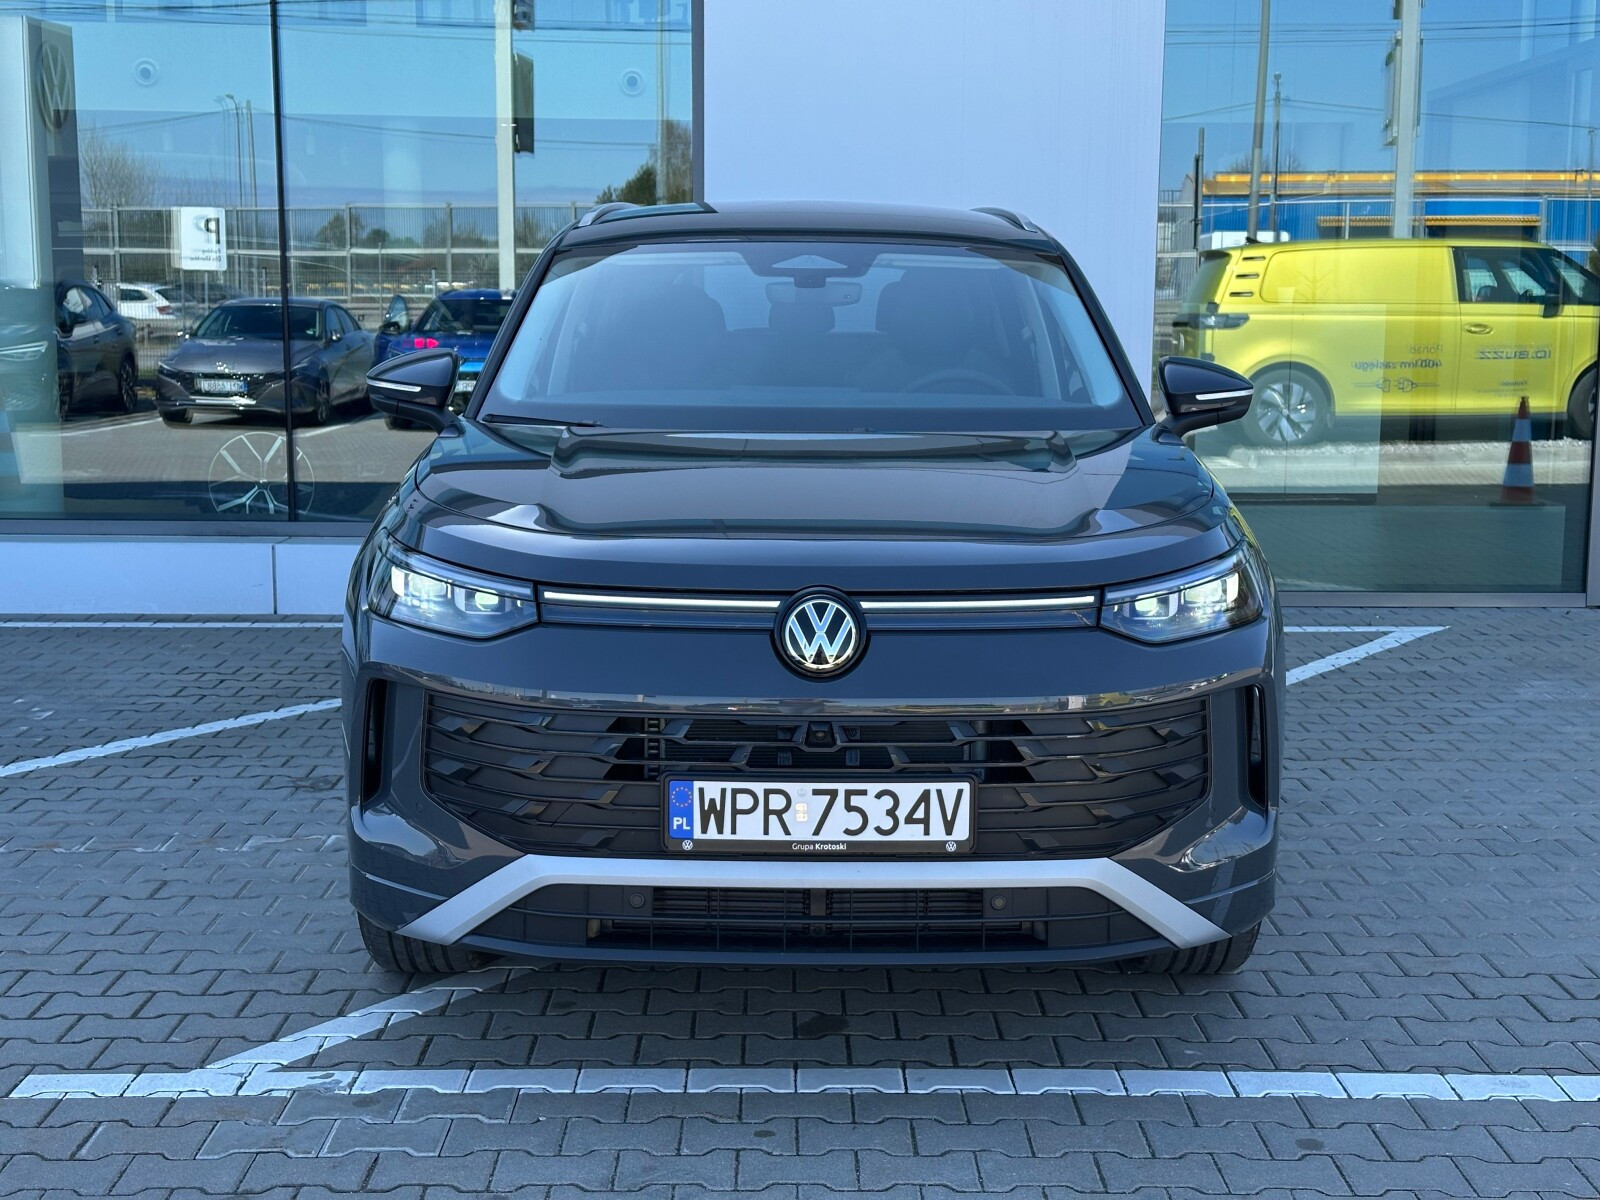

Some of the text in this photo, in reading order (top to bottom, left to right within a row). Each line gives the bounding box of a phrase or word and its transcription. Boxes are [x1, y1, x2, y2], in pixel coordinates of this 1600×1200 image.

[698, 786, 964, 837] WPR 7534V
[672, 816, 691, 831] PL
[791, 842, 847, 851] Grupa Krotoski
